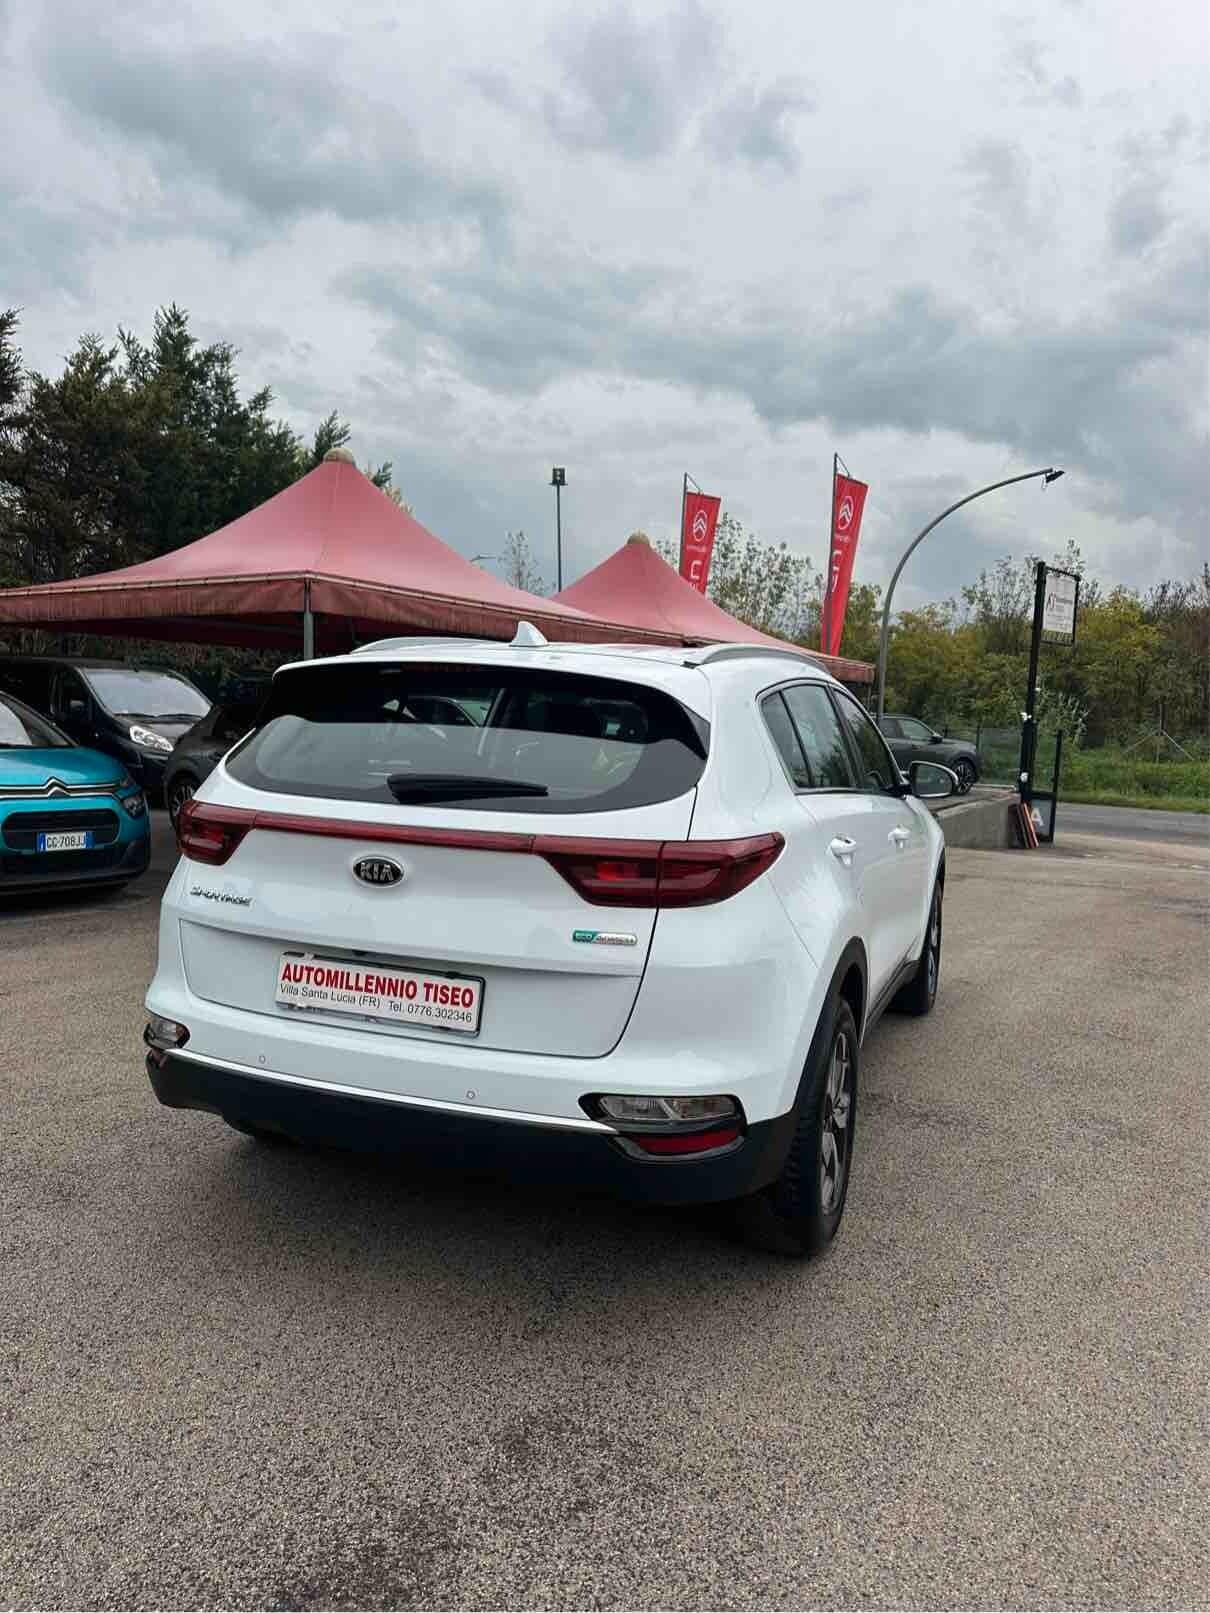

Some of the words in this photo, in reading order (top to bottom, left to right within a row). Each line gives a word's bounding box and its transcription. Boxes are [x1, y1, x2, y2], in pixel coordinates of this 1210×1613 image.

[360, 862, 394, 881] KIA
[280, 983, 299, 996] Villa
[301, 986, 328, 1000] Santa
[331, 991, 356, 1004] Lucia
[358, 994, 381, 1009] (FR)
[388, 1000, 404, 1013] Tel.
[407, 1003, 473, 1023] 0776.302346
[281, 963, 418, 1000] AUTOMILLENNIO
[423, 982, 474, 1008] TISEO
